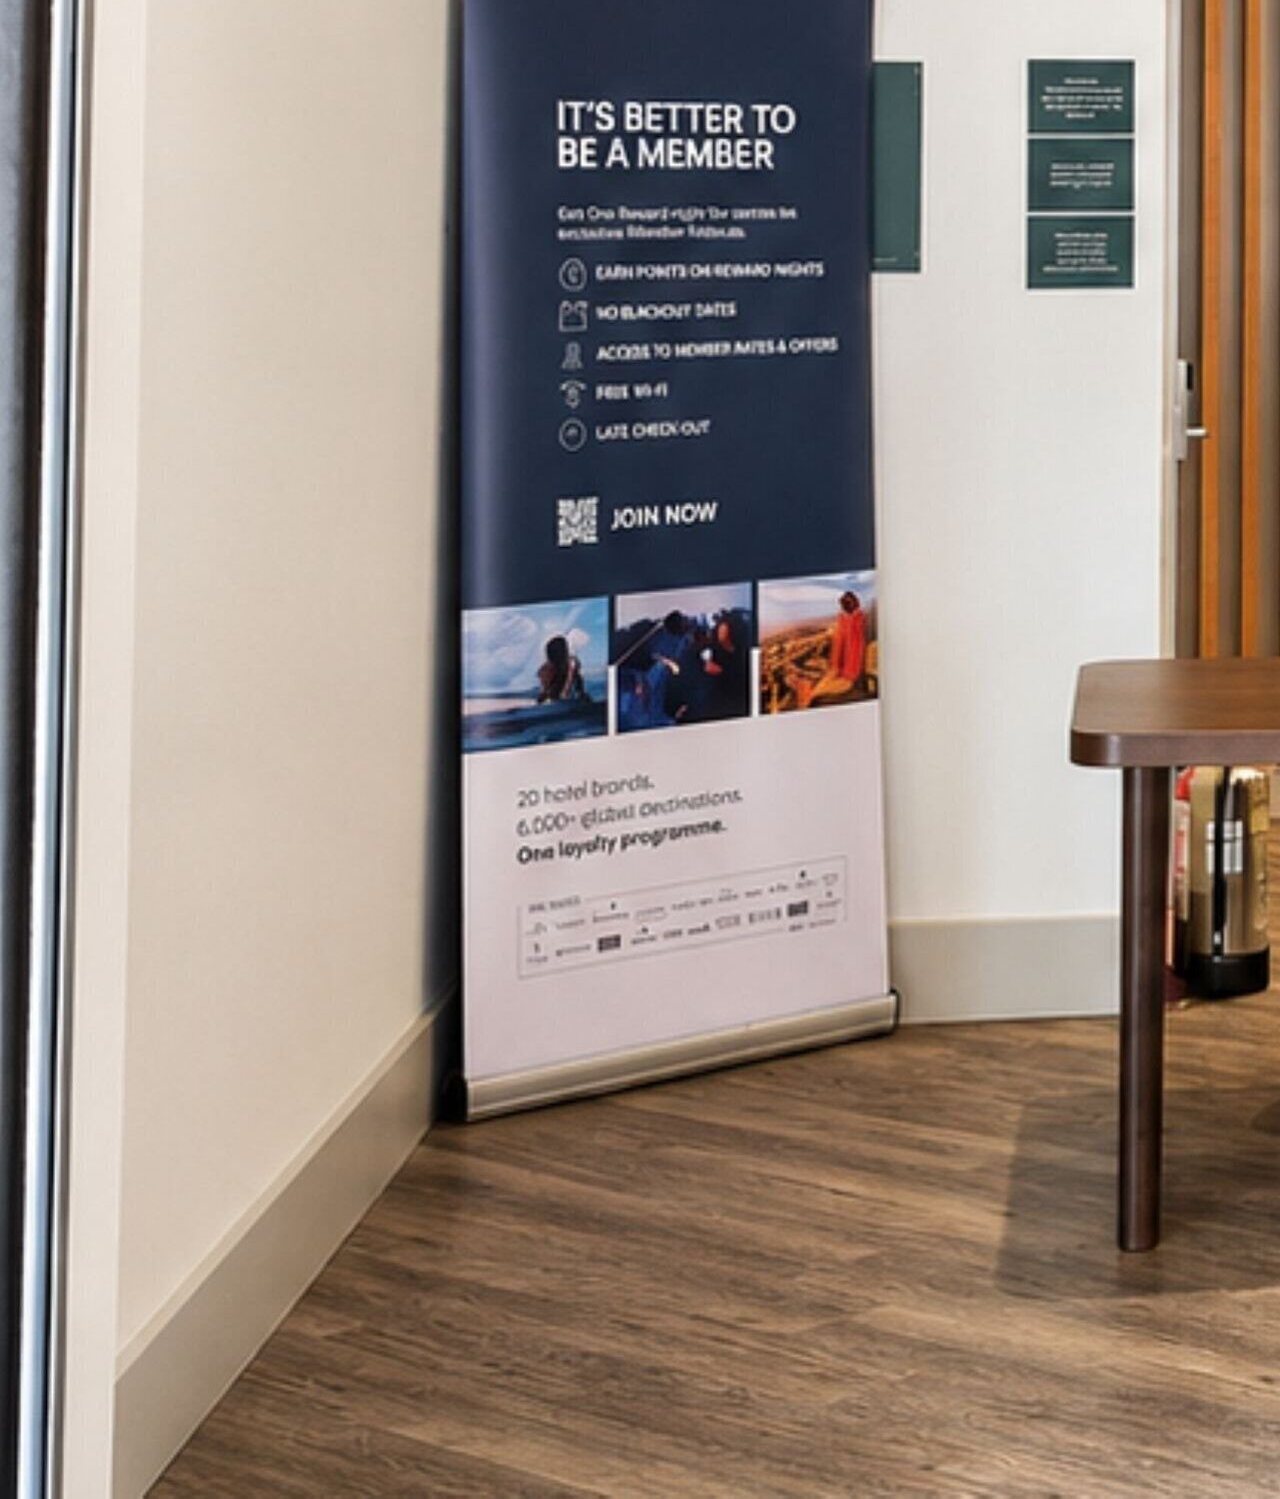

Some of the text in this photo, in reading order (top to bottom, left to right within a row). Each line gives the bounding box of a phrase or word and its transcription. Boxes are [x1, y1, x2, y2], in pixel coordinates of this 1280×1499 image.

[557, 101, 796, 134] IT'S BETTER TO
[557, 138, 774, 170] BE A MEMBER
[696, 301, 737, 317] DATES
[654, 342, 671, 358] TO
[596, 423, 629, 440] LATE
[611, 502, 718, 530] JOIN NOW
[517, 774, 654, 808] 20 hotel brands.
[516, 819, 728, 864] One loyalty programme.
